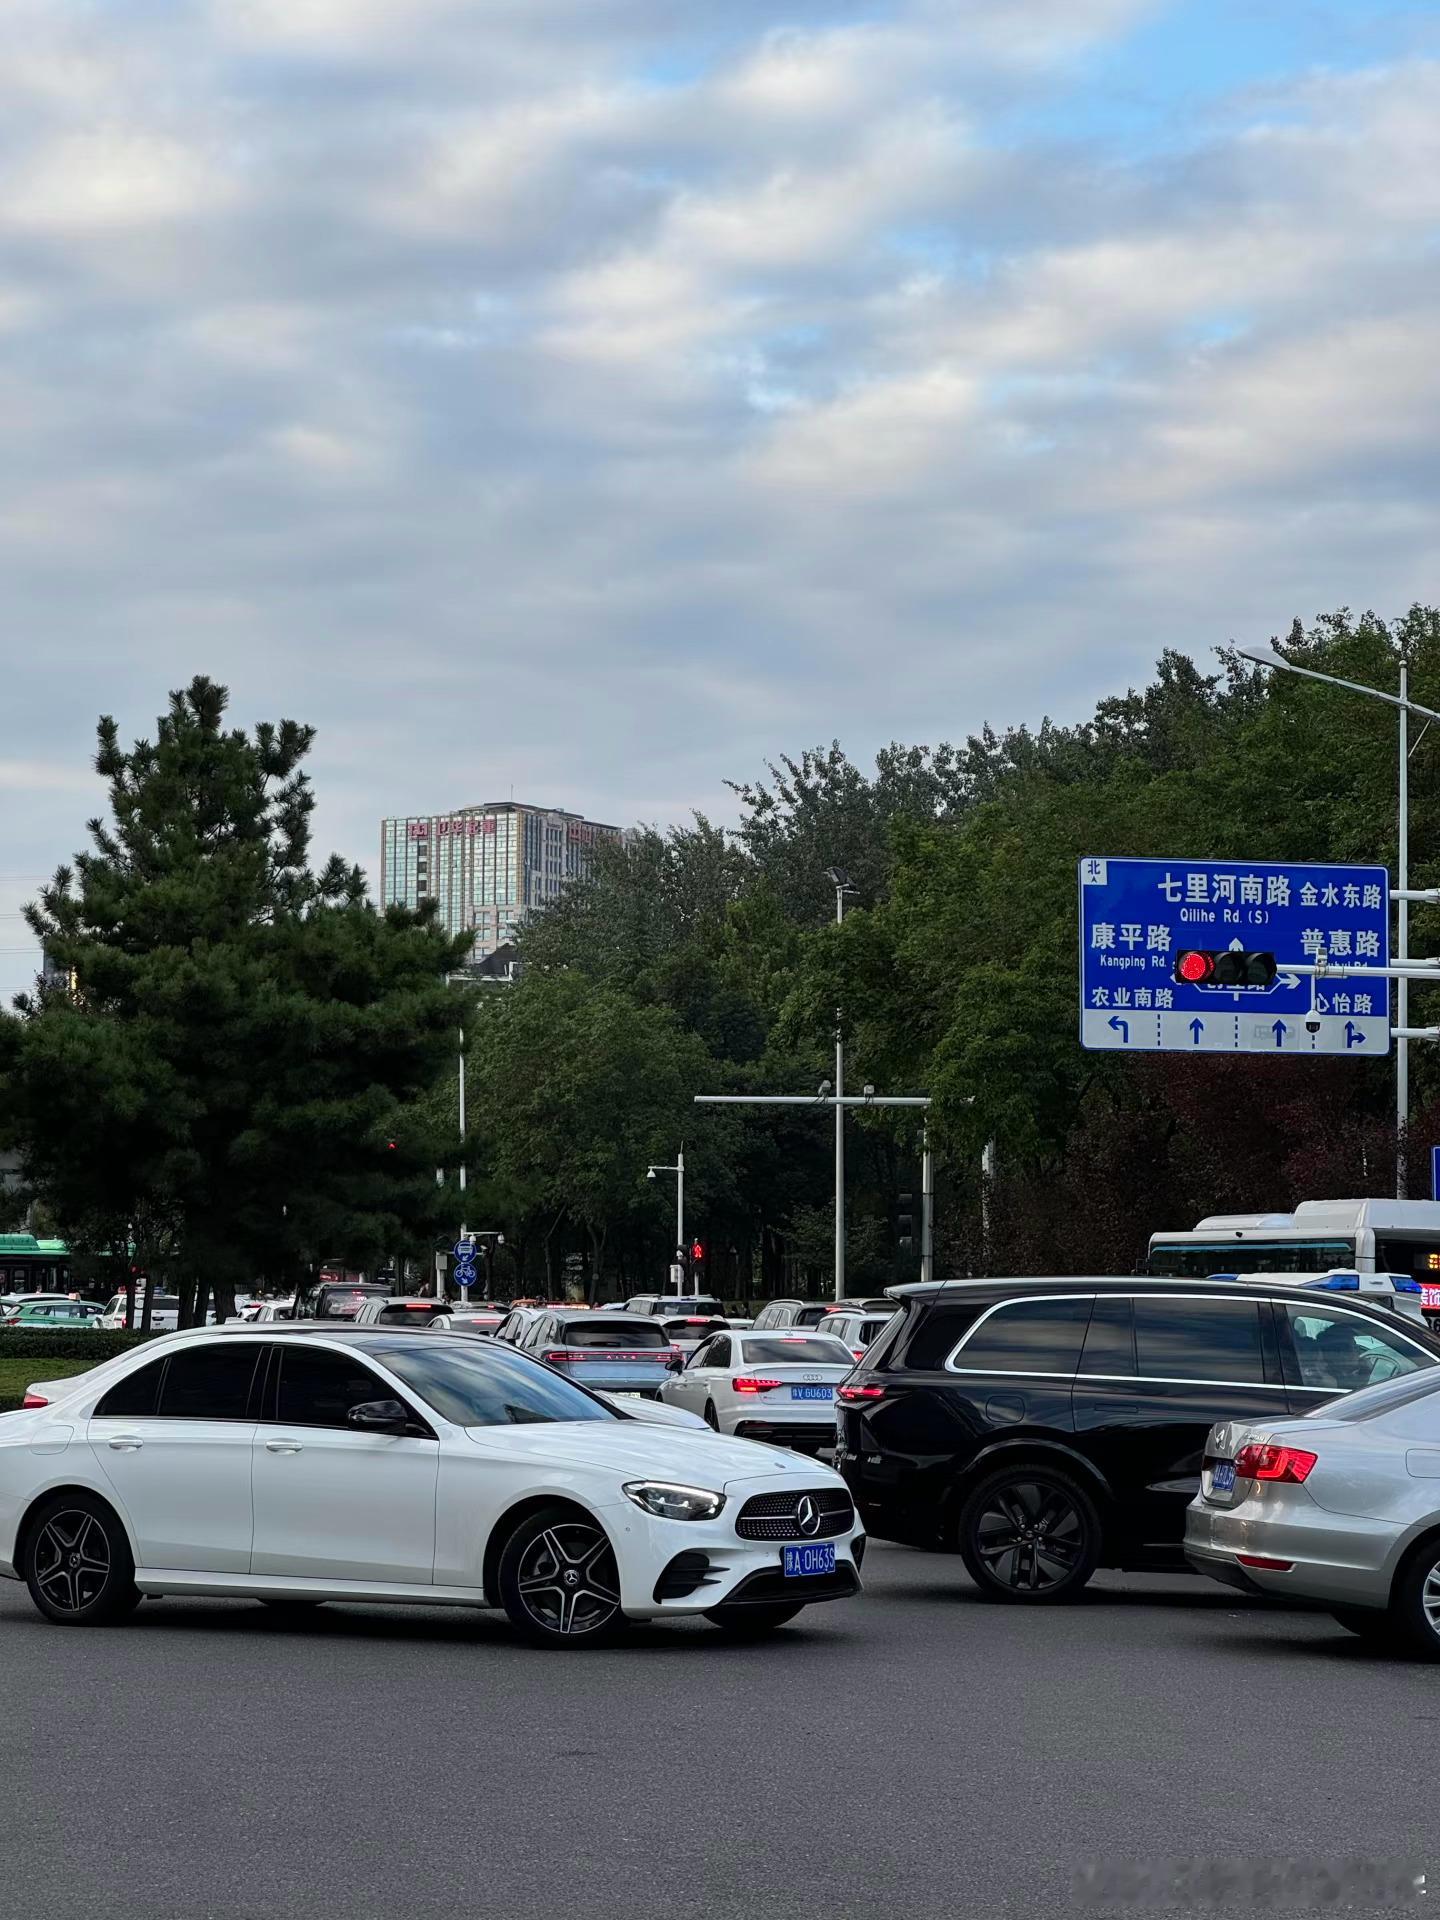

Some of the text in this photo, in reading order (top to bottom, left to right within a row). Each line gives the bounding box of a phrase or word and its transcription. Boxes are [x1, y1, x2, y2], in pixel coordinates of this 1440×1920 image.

[1087, 860, 1101, 875] 北
[1157, 872, 1292, 907] 七里河南路
[1300, 881, 1382, 910] 金水东路
[1180, 908, 1269, 924] Qilihe Rd. (S)
[1091, 922, 1172, 951] 康平路
[1300, 928, 1380, 957] 普惠路
[1100, 954, 1146, 970] Kangping
[1152, 955, 1167, 968] Rd.
[1091, 986, 1174, 1009] 农业南路
